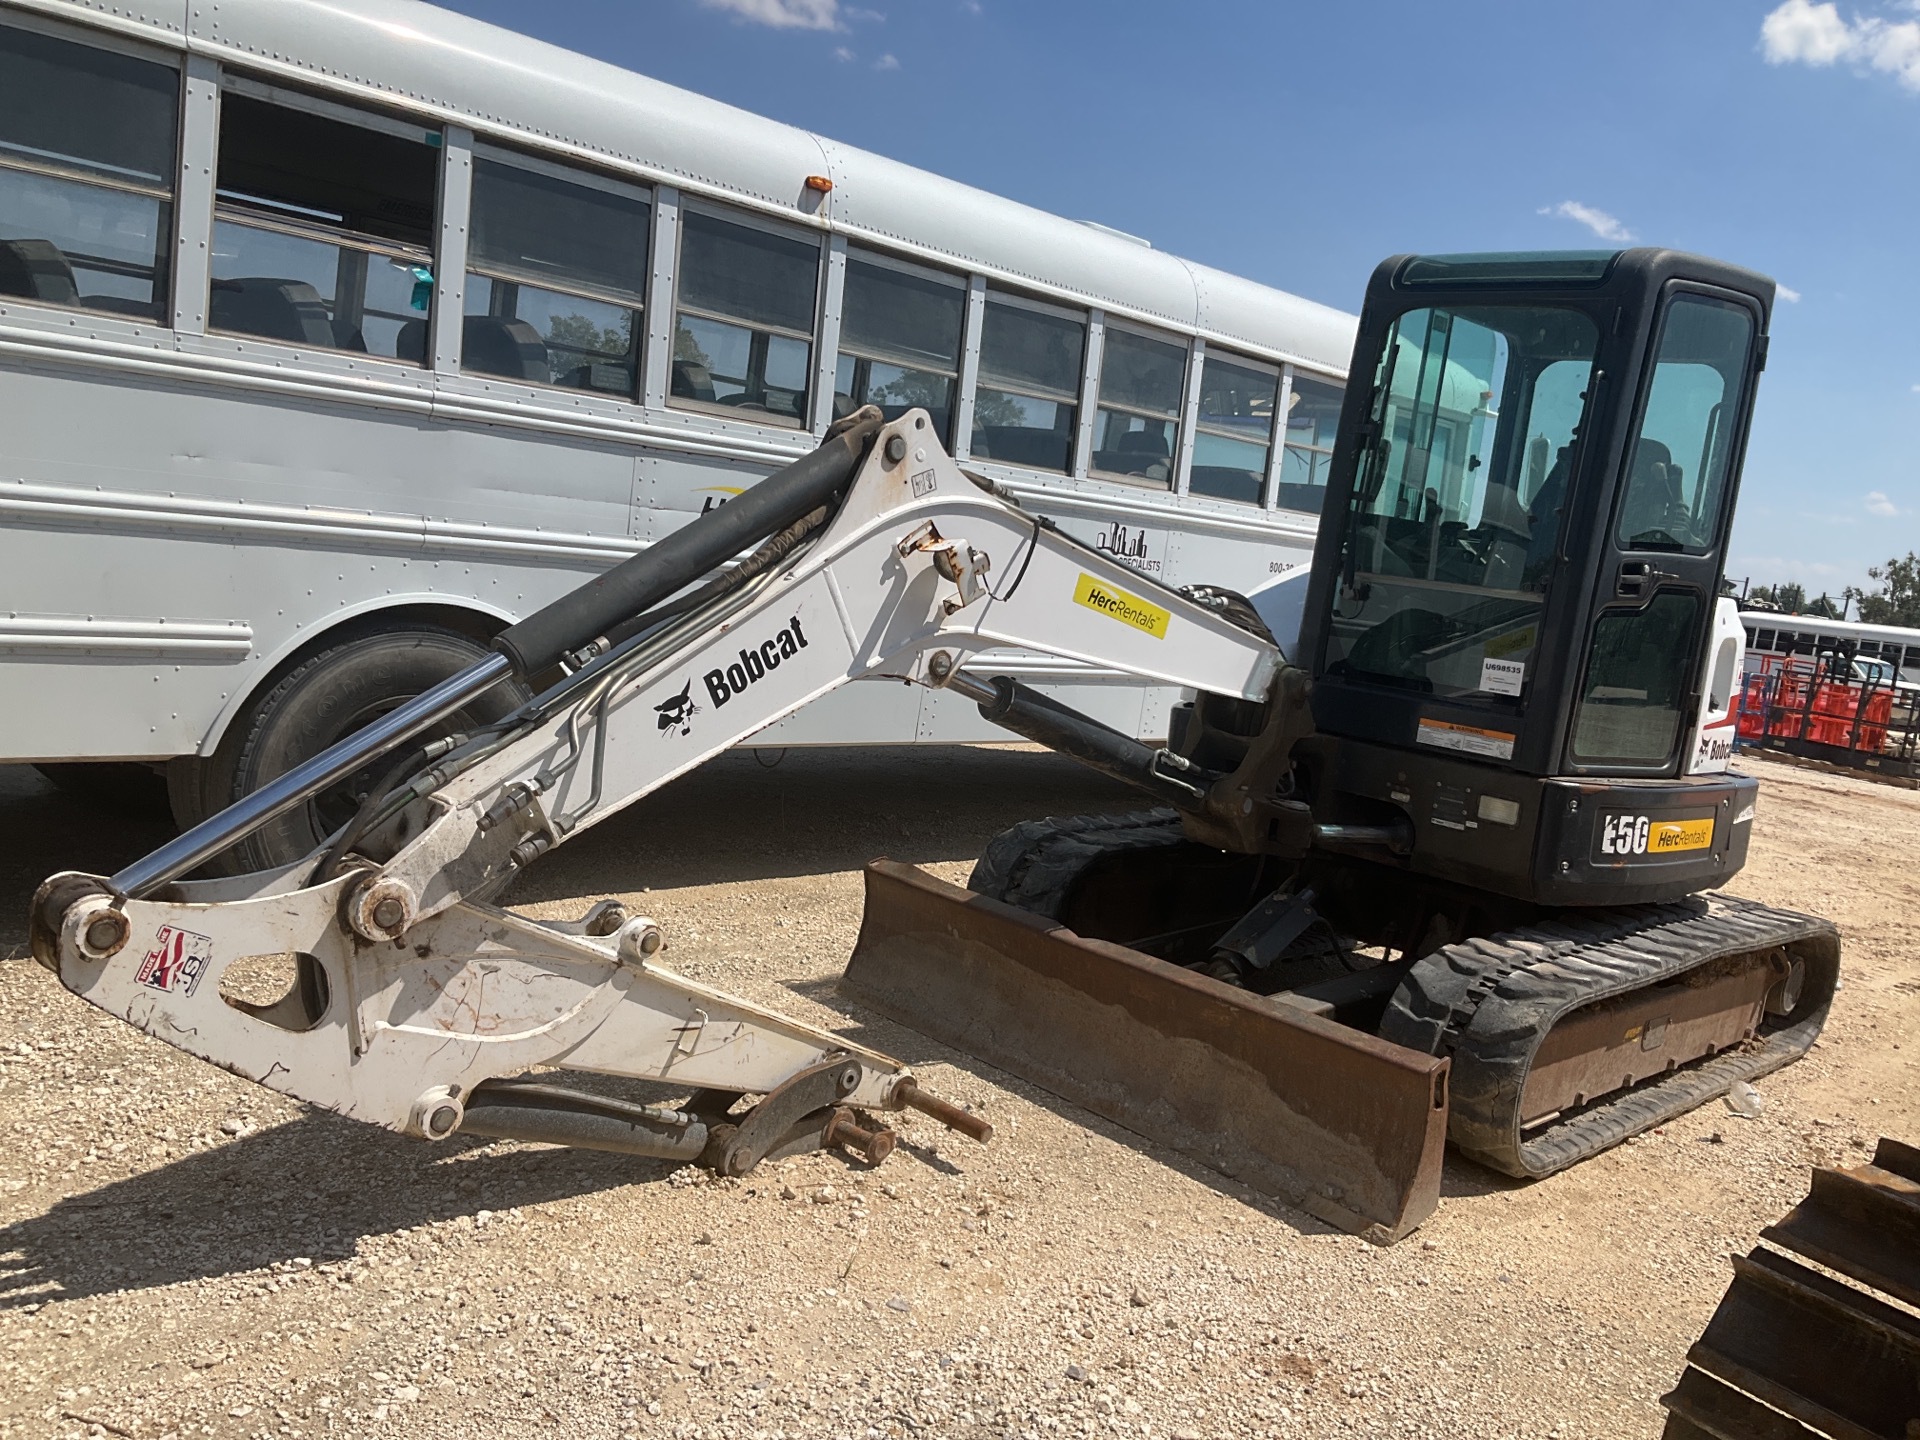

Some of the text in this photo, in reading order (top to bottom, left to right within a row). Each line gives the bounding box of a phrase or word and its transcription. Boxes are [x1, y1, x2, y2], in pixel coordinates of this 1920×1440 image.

[703, 616, 808, 709] Bobcat
[1485, 663, 1521, 674] U698535
[140, 957, 156, 980] MADE
[160, 931, 169, 942] HE
